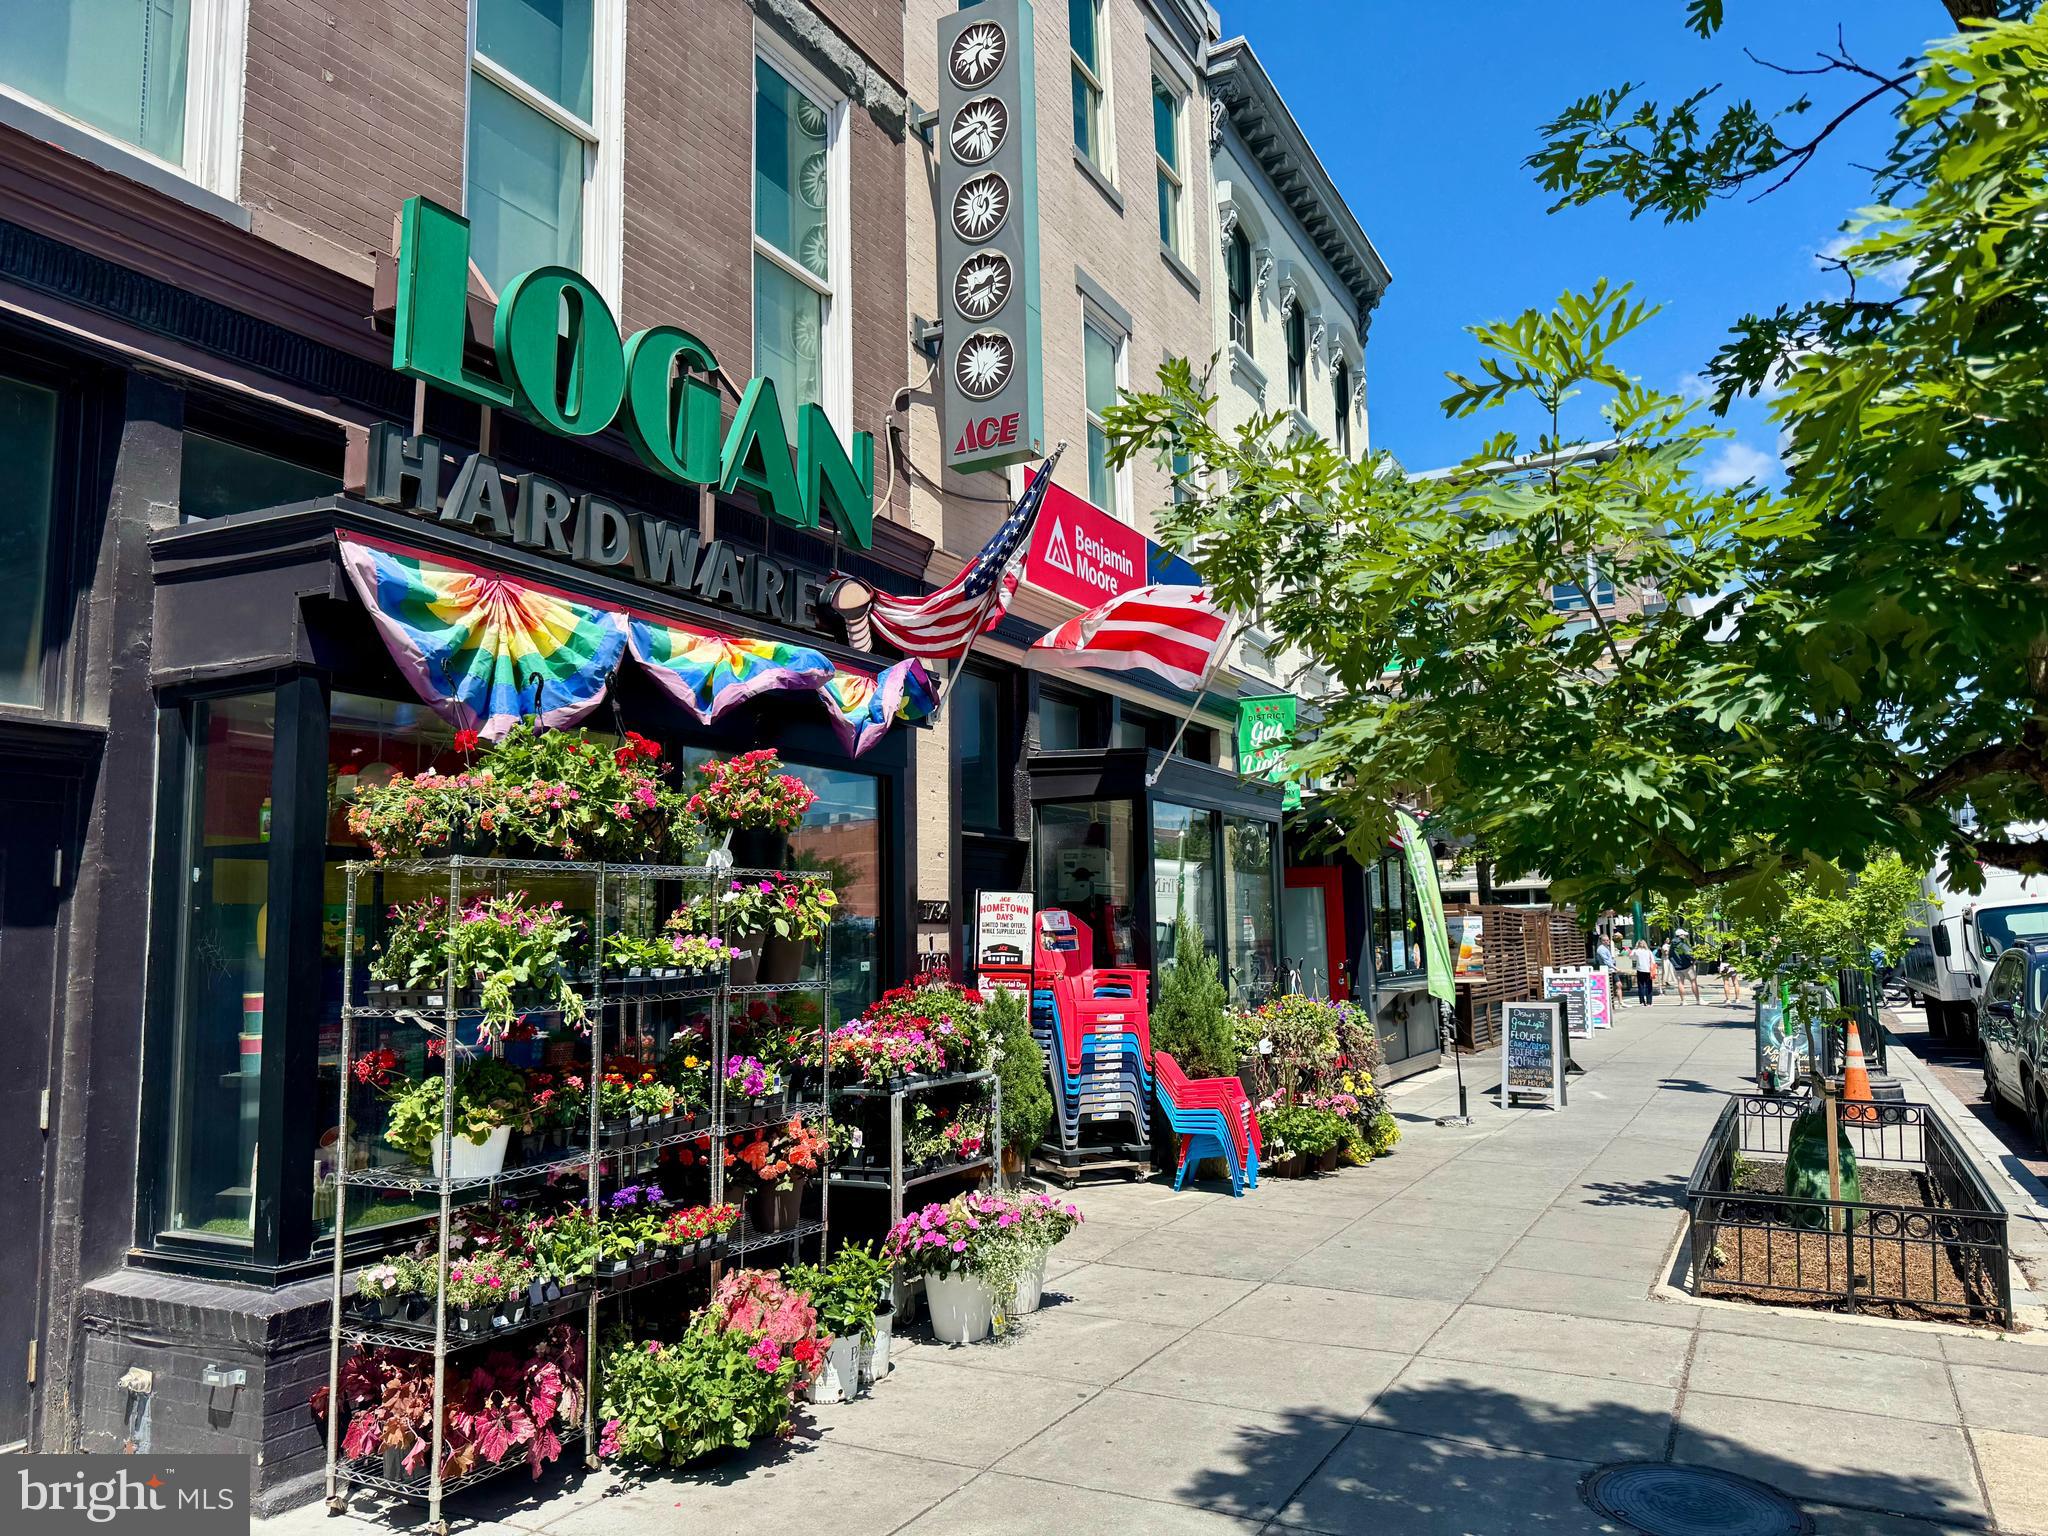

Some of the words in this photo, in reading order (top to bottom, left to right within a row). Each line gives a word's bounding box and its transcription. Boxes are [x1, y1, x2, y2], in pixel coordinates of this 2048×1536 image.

[393, 195, 874, 552] LOGAN
[954, 412, 1021, 456] ACE
[365, 420, 817, 630] HARDWARE
[1075, 525, 1134, 578] Benjamin
[1076, 554, 1119, 596] Moore
[1248, 712, 1286, 722] DISTRICT
[1250, 720, 1286, 748] Gas
[923, 903, 947, 919] 1734
[980, 904, 1029, 916] HOMETOWN
[998, 944, 1009, 952] ACE
[921, 954, 947, 972] 1736
[1510, 1030, 1543, 1042] FLOWER
[1509, 1047, 1545, 1058] EDIBLES
[1527, 1079, 1547, 1088] HOUR
